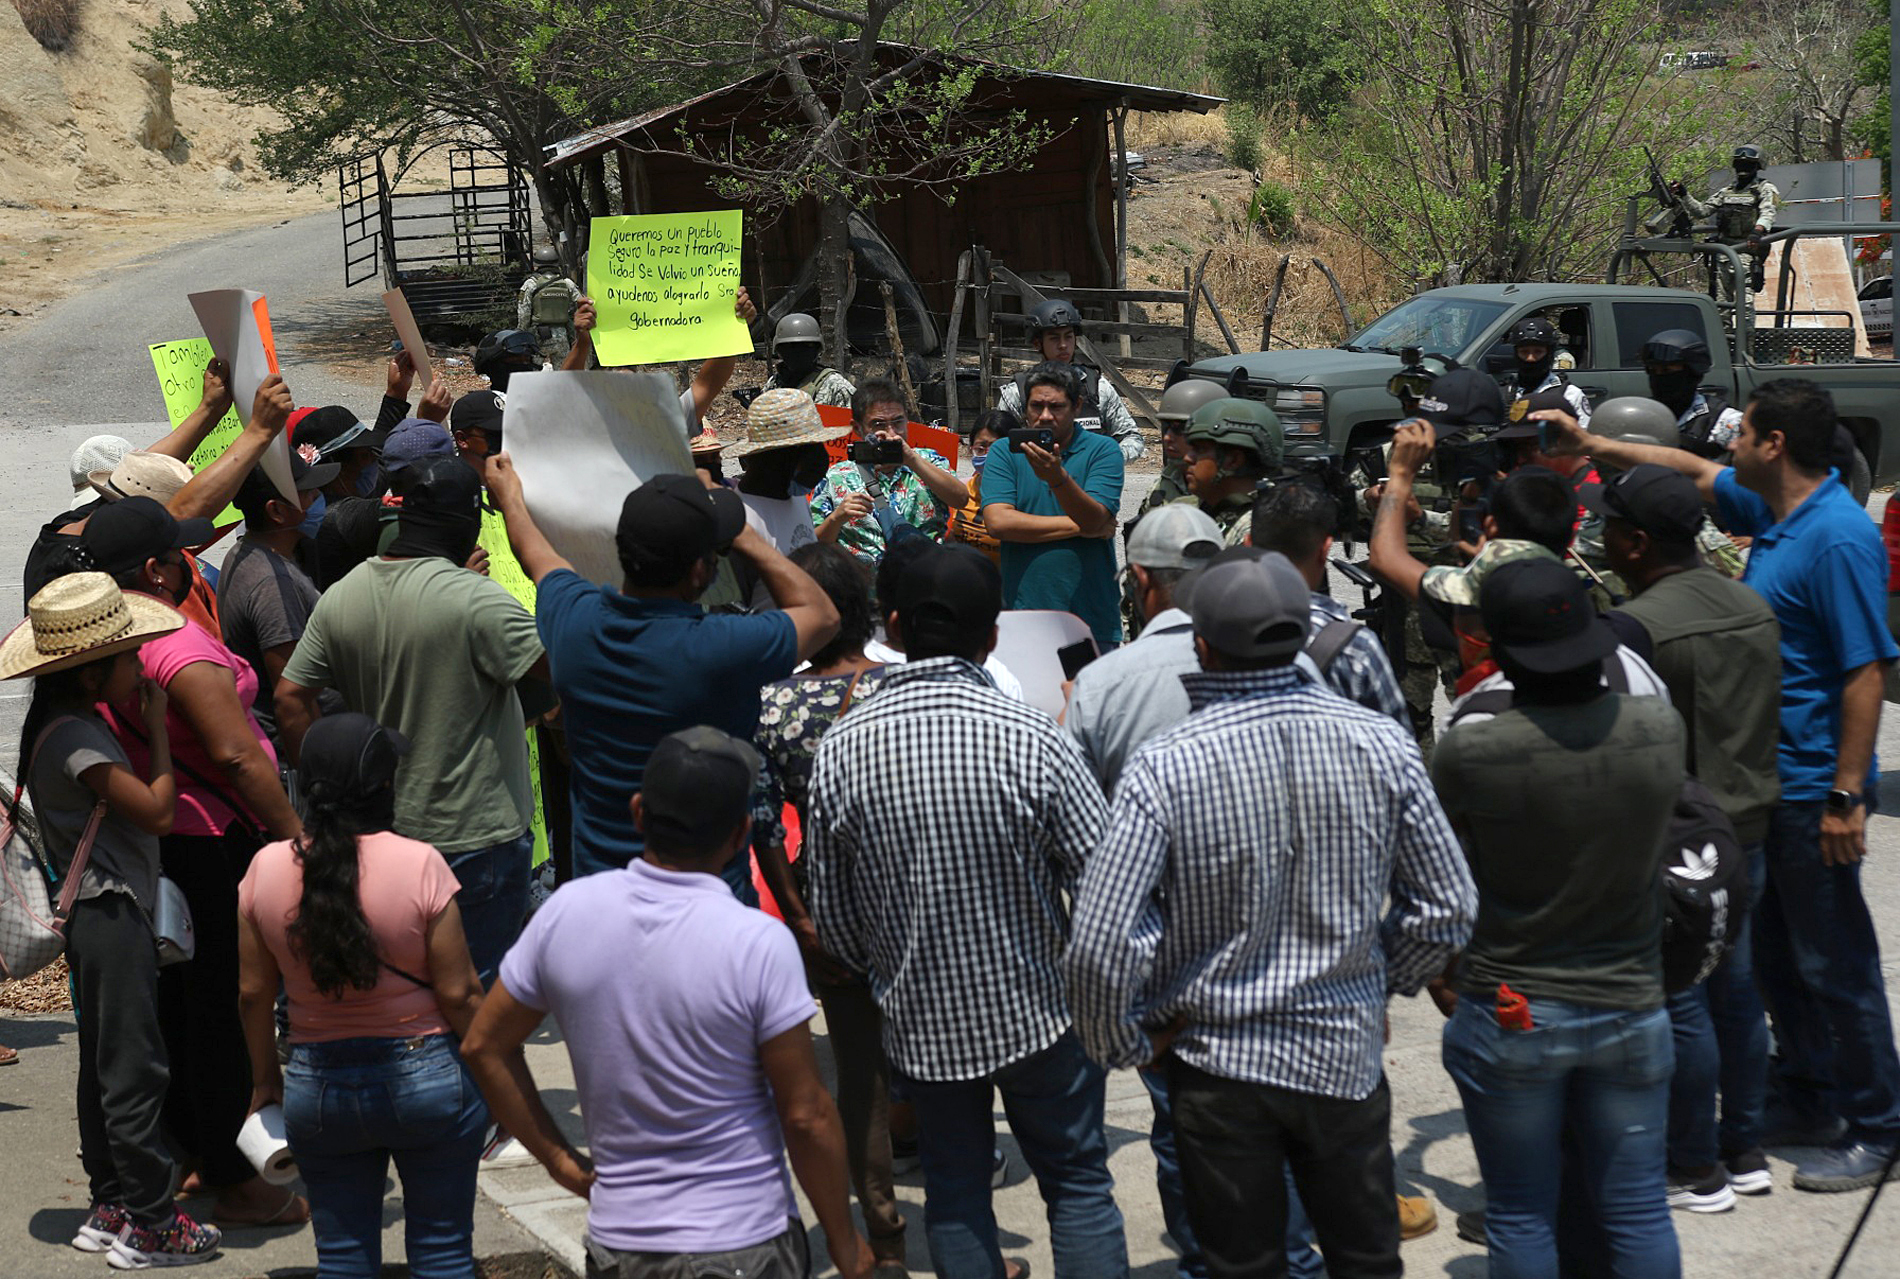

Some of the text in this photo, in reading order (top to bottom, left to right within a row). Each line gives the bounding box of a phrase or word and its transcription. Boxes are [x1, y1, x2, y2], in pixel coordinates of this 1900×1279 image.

[610, 228, 662, 246] Queremos
[660, 245, 681, 258] paz
[609, 260, 634, 278] lidad
[607, 285, 658, 305] ayudenos
